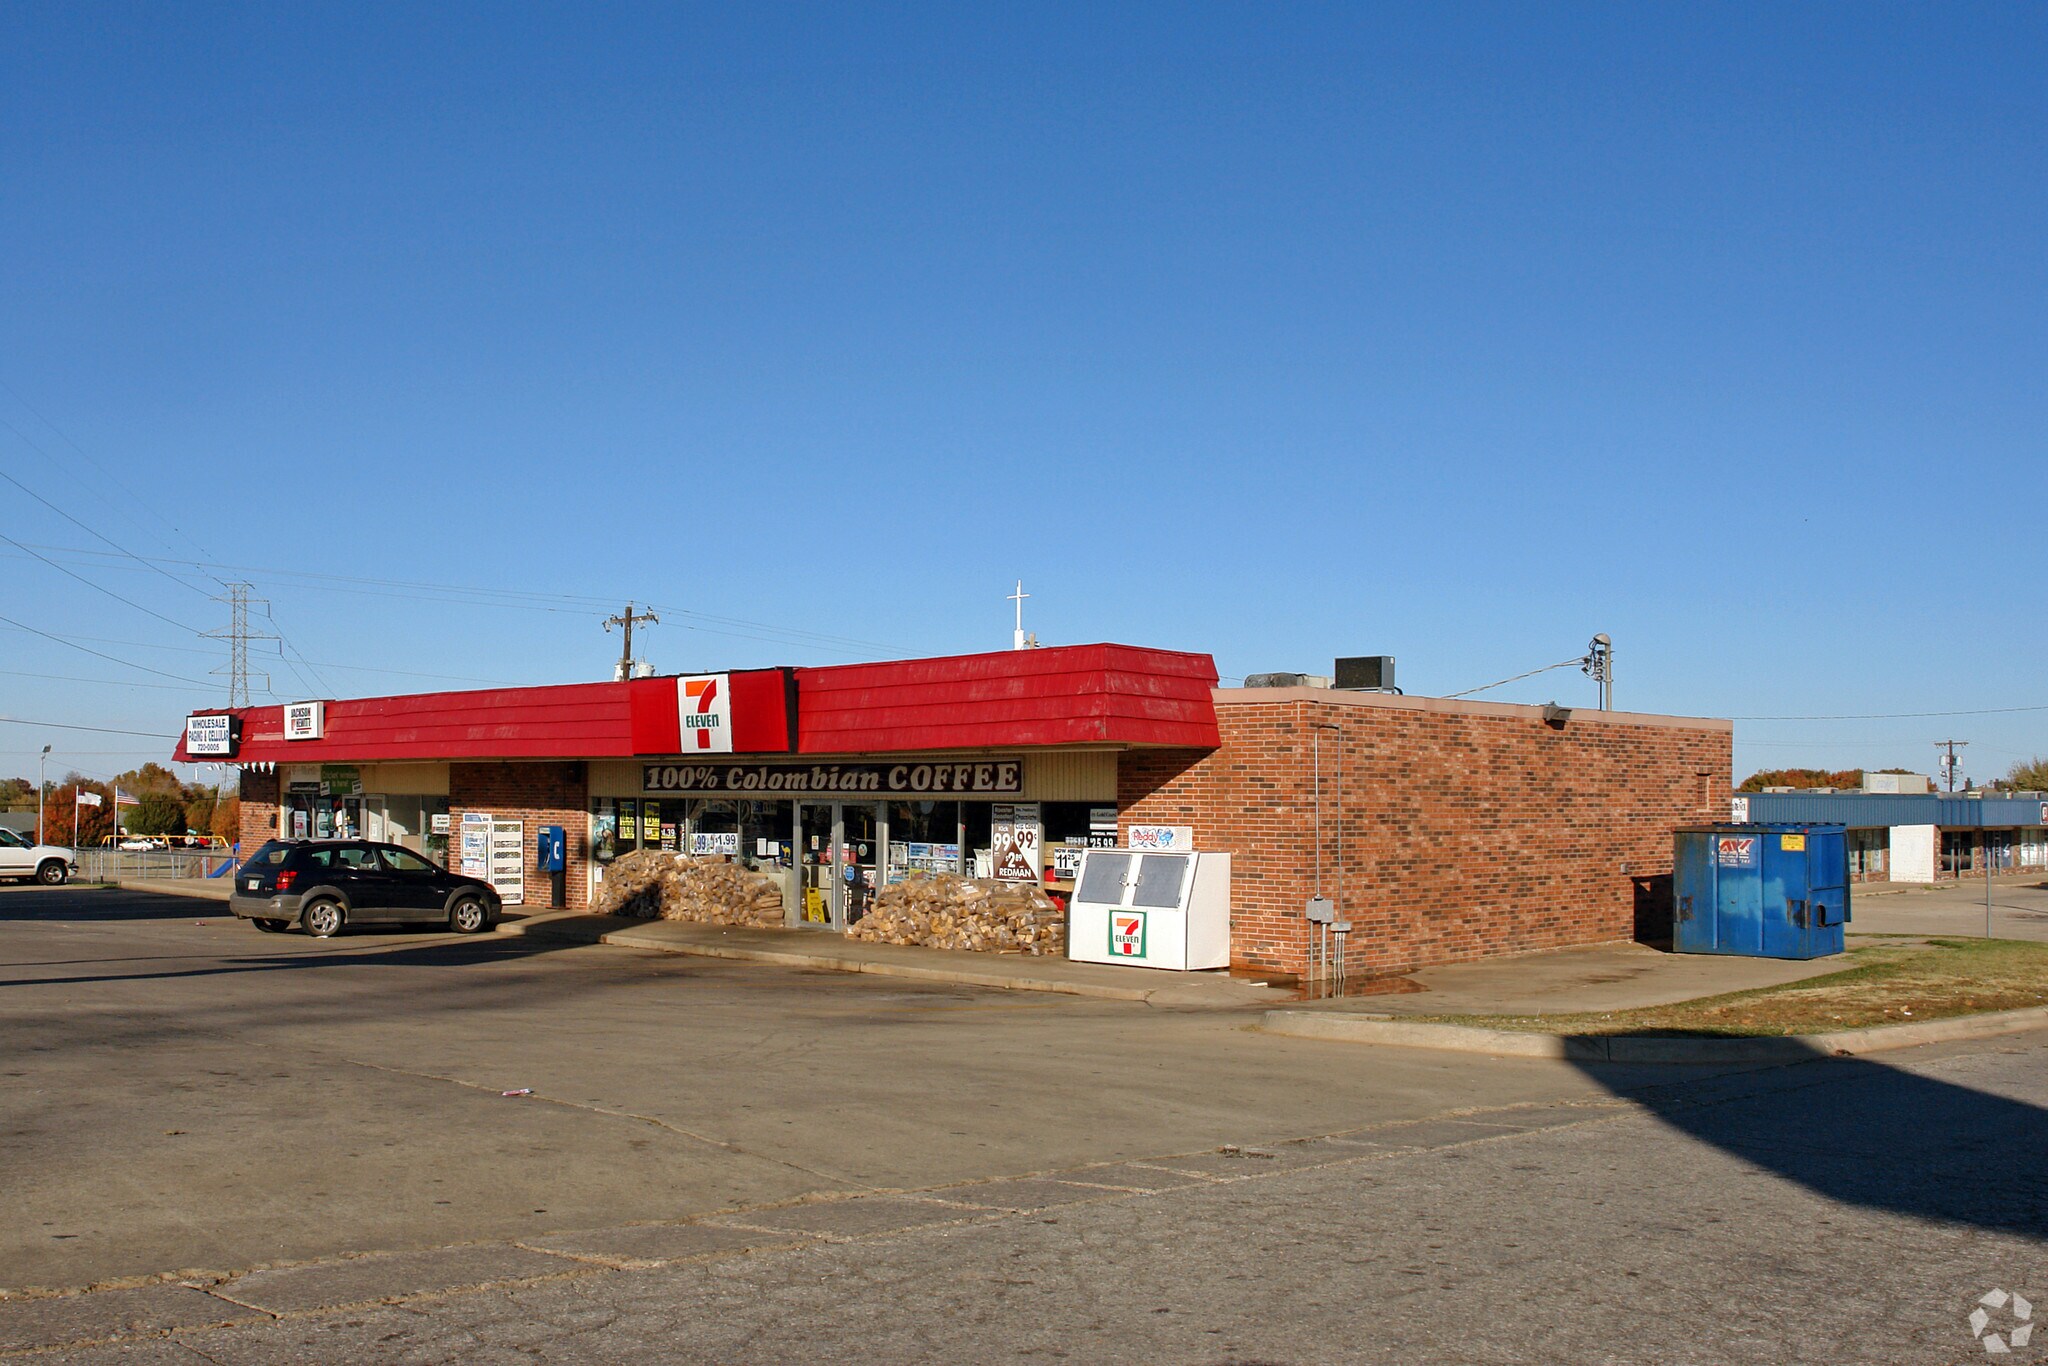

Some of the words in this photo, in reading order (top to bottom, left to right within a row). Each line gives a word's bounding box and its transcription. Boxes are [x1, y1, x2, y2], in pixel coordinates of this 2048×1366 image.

[291, 707, 311, 718] JACKSON
[685, 679, 717, 749] 7
[191, 718, 226, 729] WHOLESALE
[296, 718, 311, 728] HEWITT
[188, 730, 203, 742] PAGING
[203, 730, 207, 742] &
[208, 730, 229, 742] CELLULAR
[197, 743, 220, 751] 720-0005
[647, 766, 718, 789] 100%
[725, 765, 879, 791] Colombian
[888, 763, 1019, 791] COFFEE
[1132, 831, 1158, 843] Reddy
[999, 868, 1031, 877] REDMAN
[1117, 918, 1138, 954] 7
